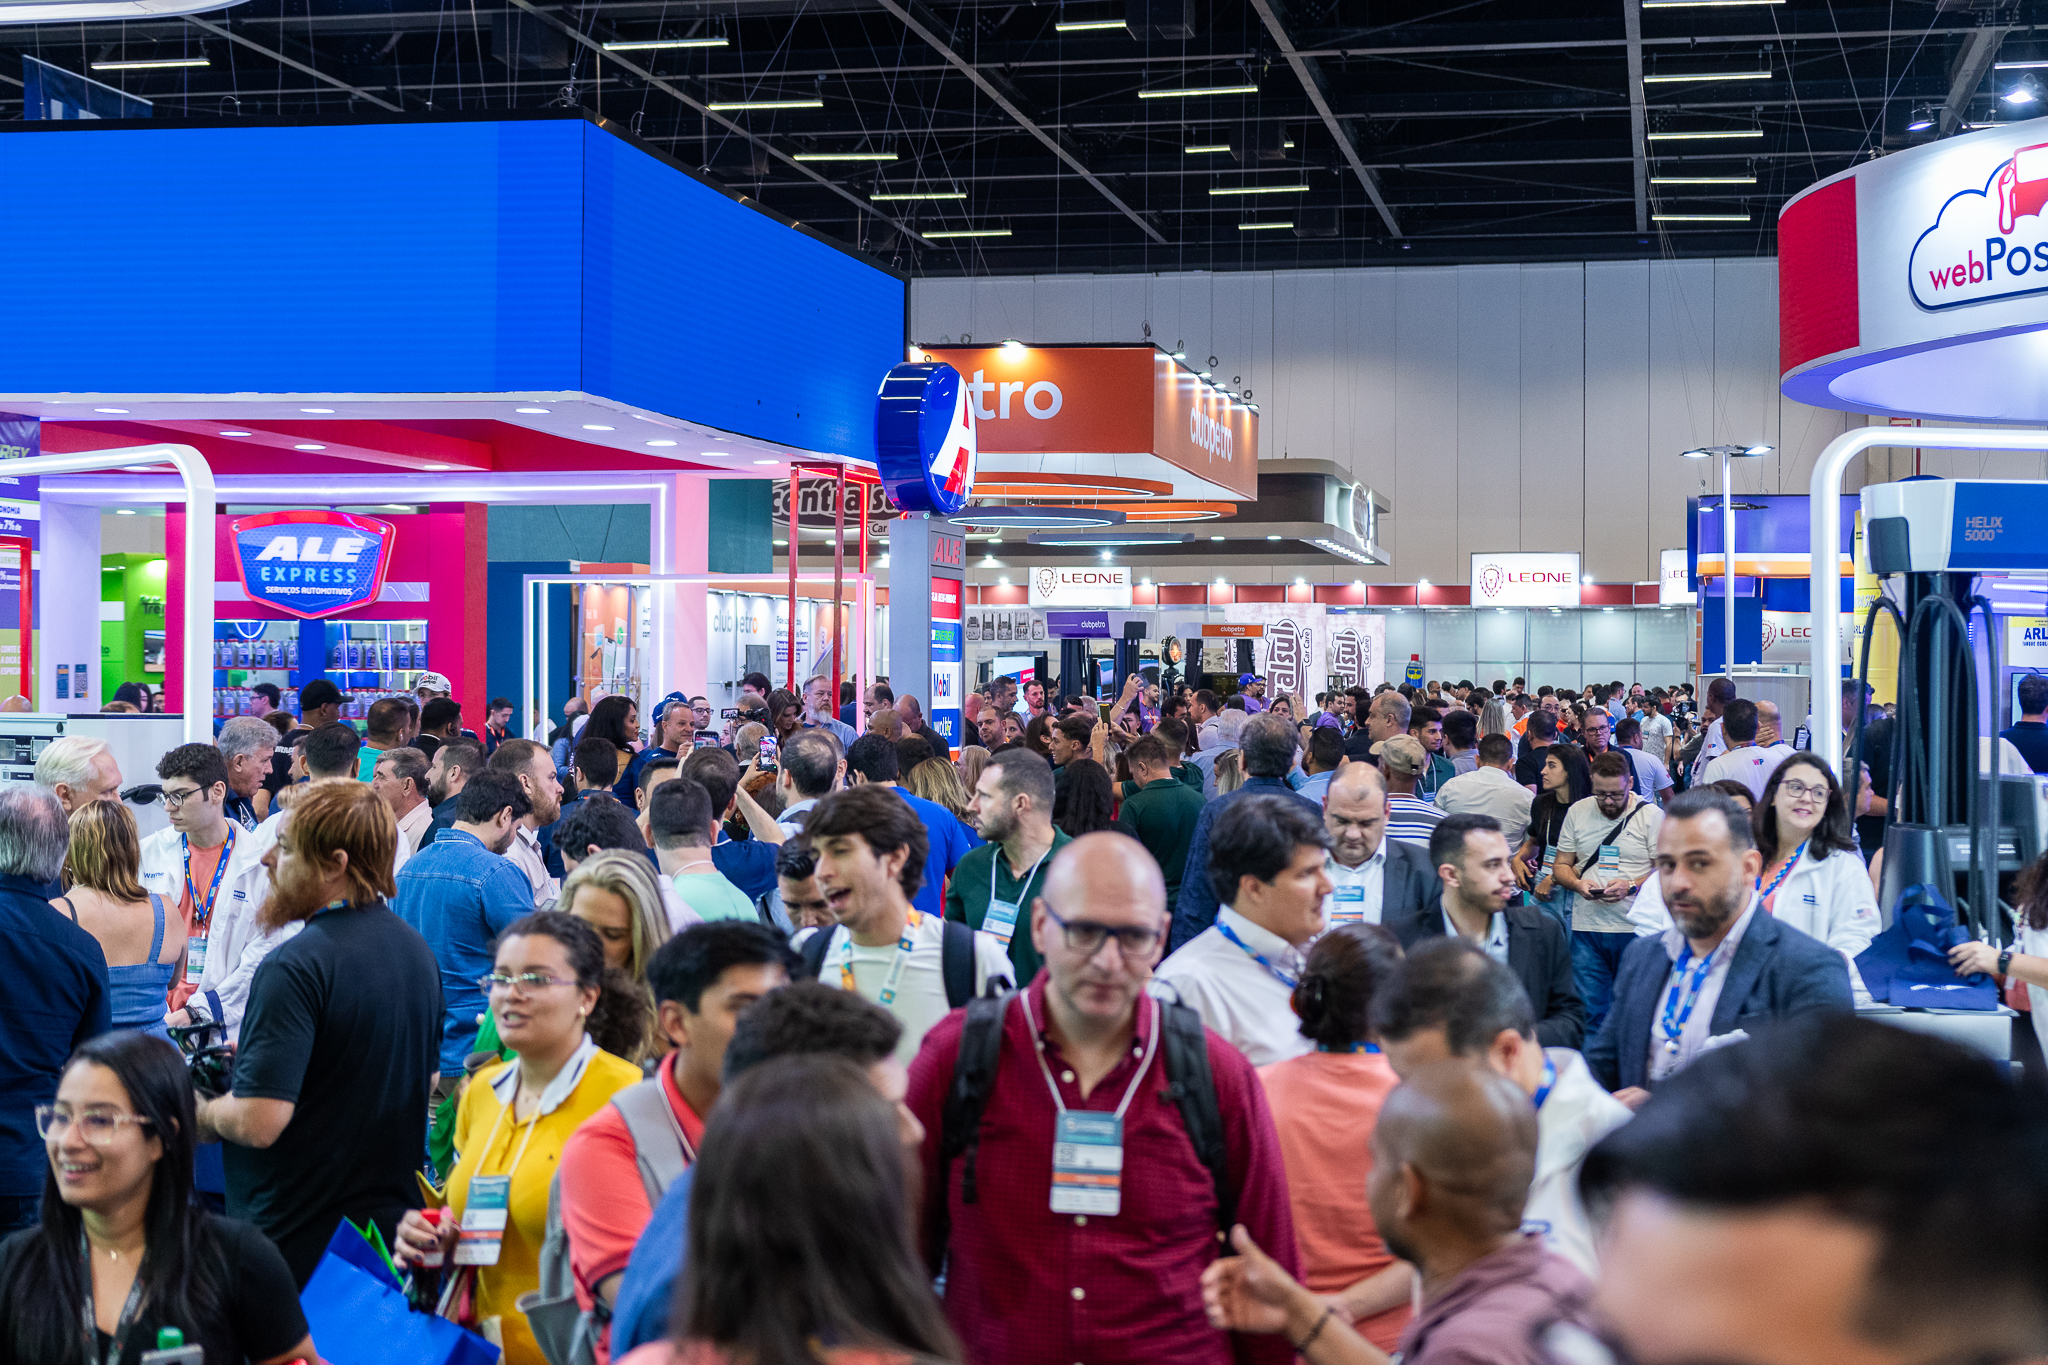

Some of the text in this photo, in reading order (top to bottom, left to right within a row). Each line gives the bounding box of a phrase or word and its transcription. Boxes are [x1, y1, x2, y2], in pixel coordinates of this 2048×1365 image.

[1190, 402, 1233, 464] clubpetro
[1965, 517, 2003, 528] HELIX
[254, 536, 366, 562] ALE
[933, 537, 962, 565] ALE
[260, 566, 356, 584] EXPRESS
[1062, 573, 1123, 584] LEONE
[1508, 572, 1572, 582] LEONE
[265, 586, 353, 596] SERVIÇOS AUTOMOTIVOS
[1081, 620, 1106, 630] clubpetro
[1220, 626, 1246, 634] clubpetro
[932, 629, 956, 642] ENERGY
[934, 673, 951, 697] Mobil
